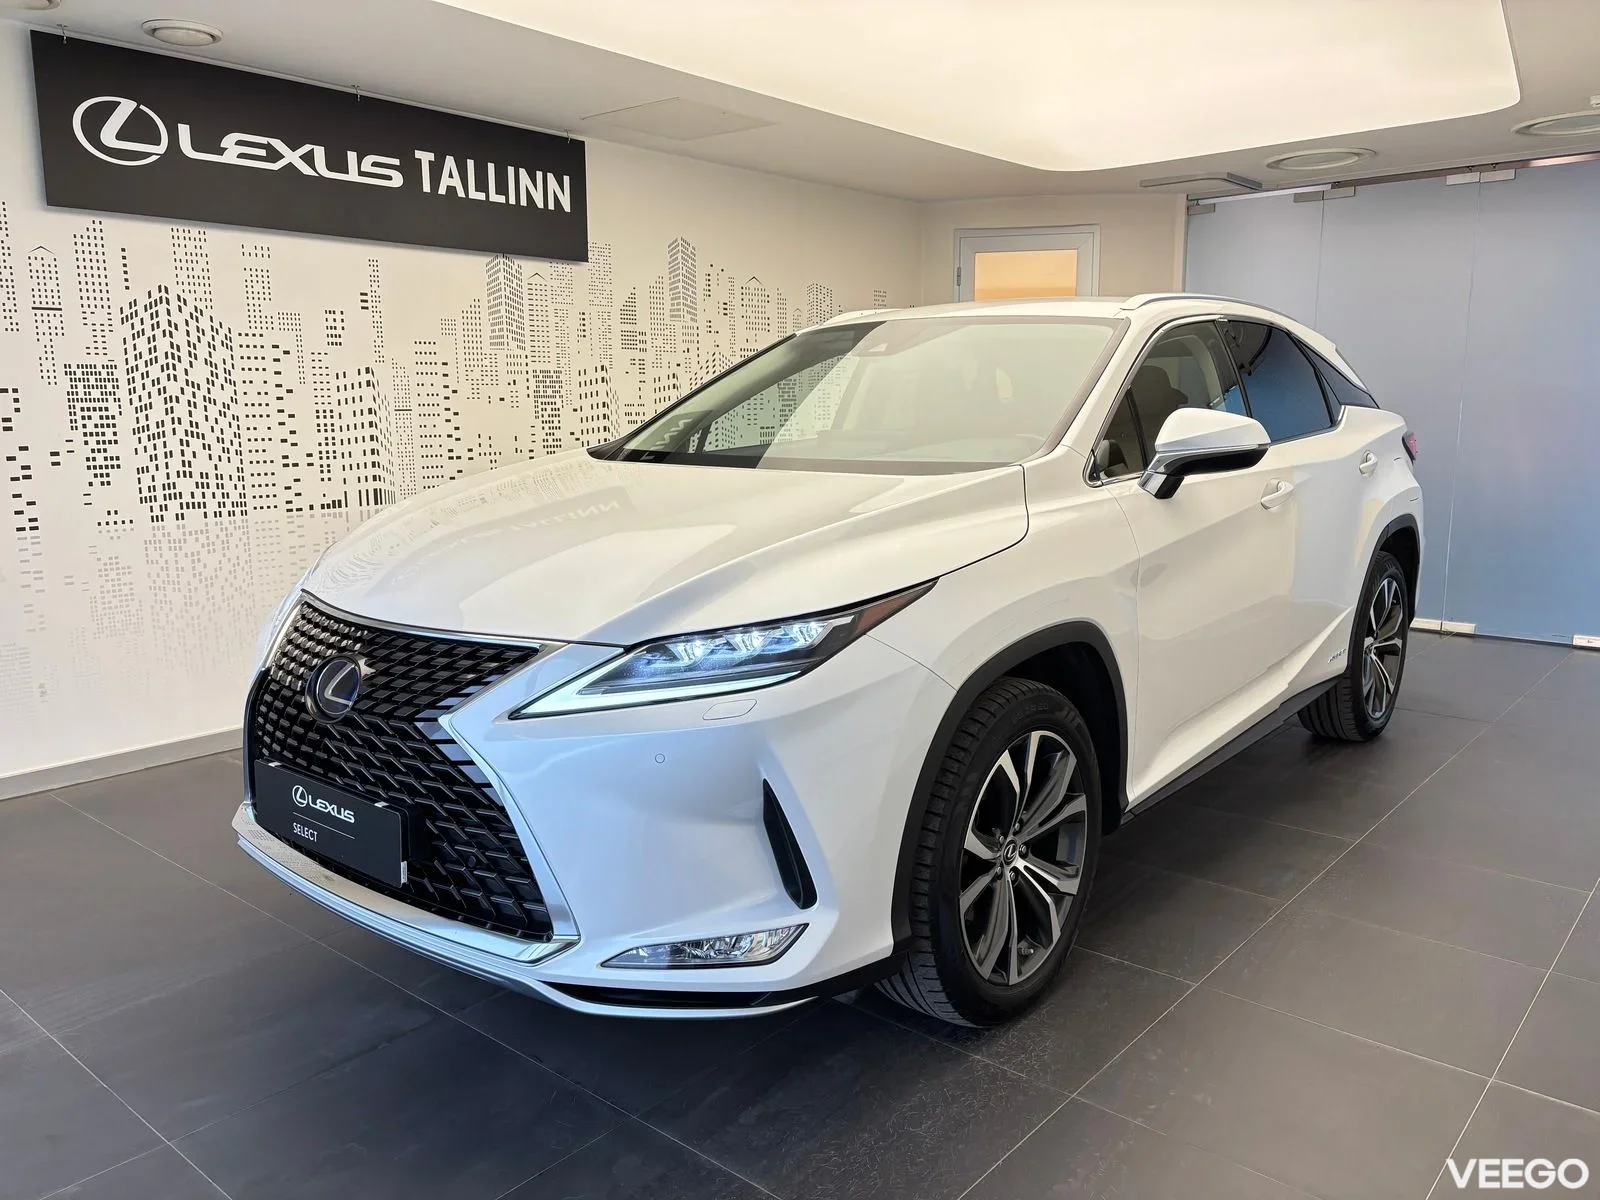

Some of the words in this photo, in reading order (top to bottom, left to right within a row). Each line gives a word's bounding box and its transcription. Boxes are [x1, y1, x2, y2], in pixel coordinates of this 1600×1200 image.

[178, 123, 404, 188] LEXUS
[414, 149, 571, 213] TALLINN
[309, 795, 355, 823] LEXUS
[292, 822, 318, 842] SELECT
